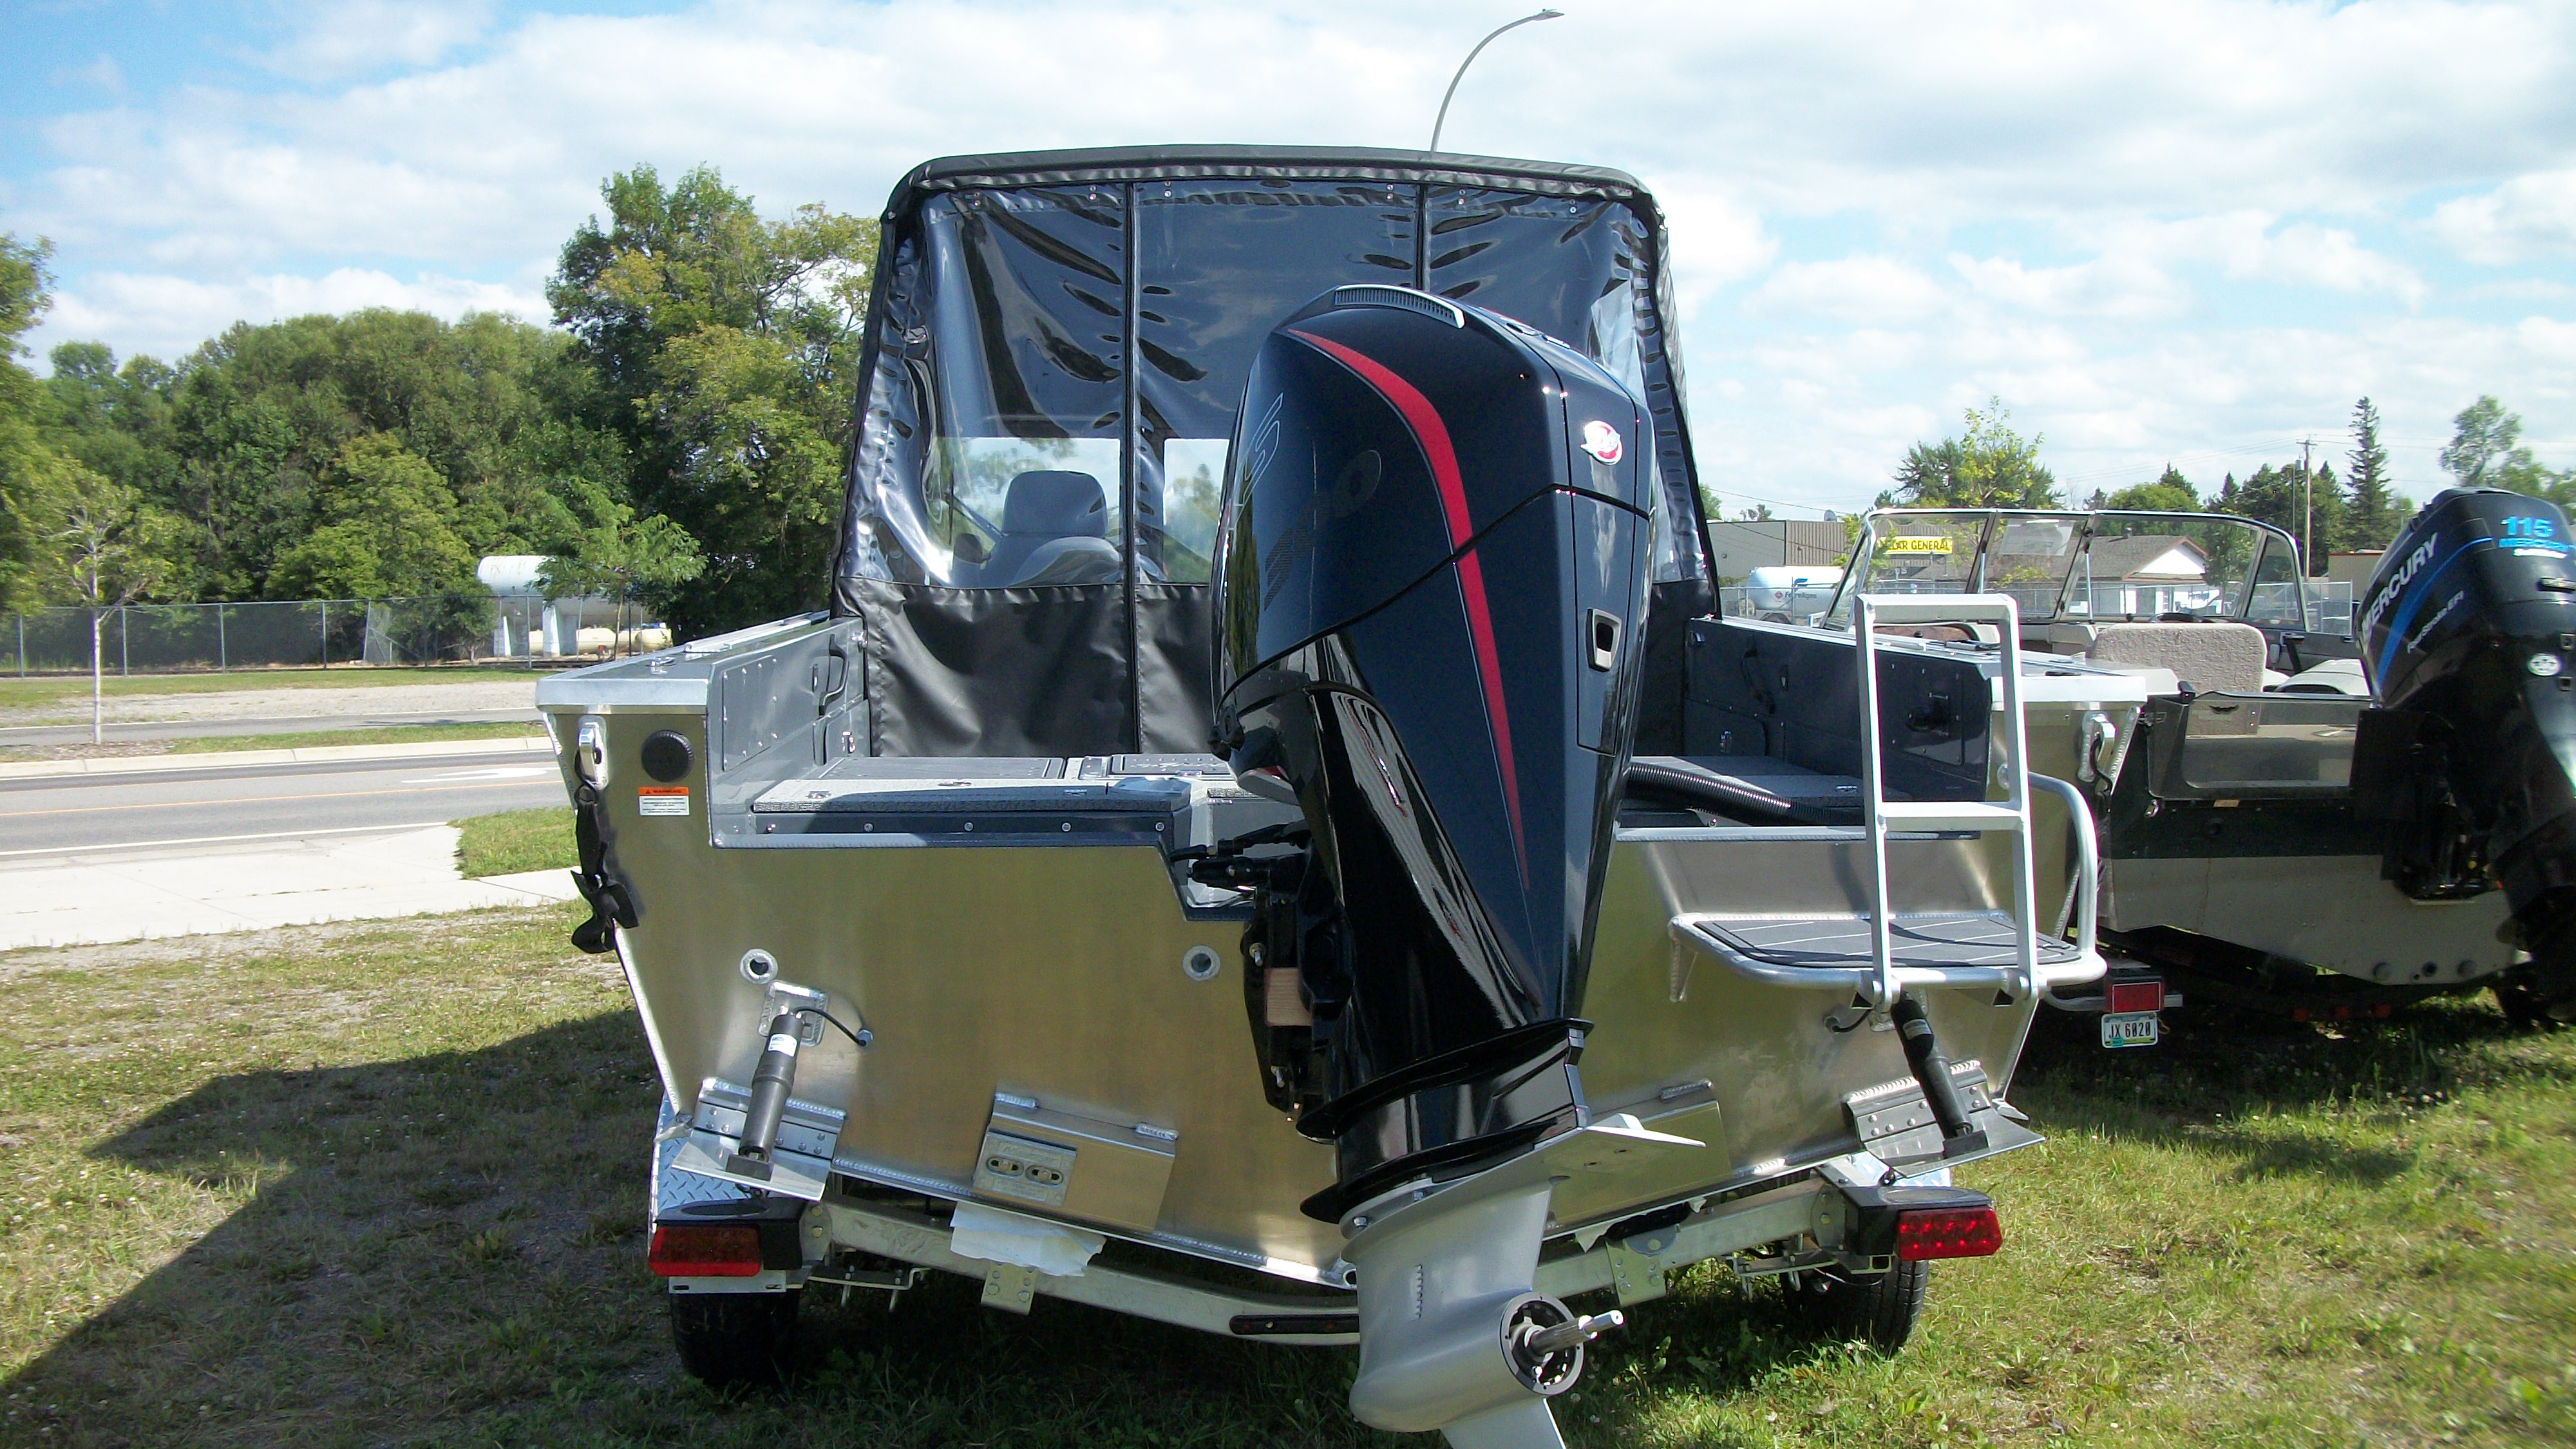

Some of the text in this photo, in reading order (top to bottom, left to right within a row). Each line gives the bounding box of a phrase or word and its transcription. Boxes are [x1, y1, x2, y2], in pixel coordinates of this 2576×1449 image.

[2500, 515, 2553, 538] 115
[1911, 540, 1950, 551] GENERAL
[2361, 532, 2439, 652] MERCURY
[2108, 1021, 2152, 1039] JX 6020
